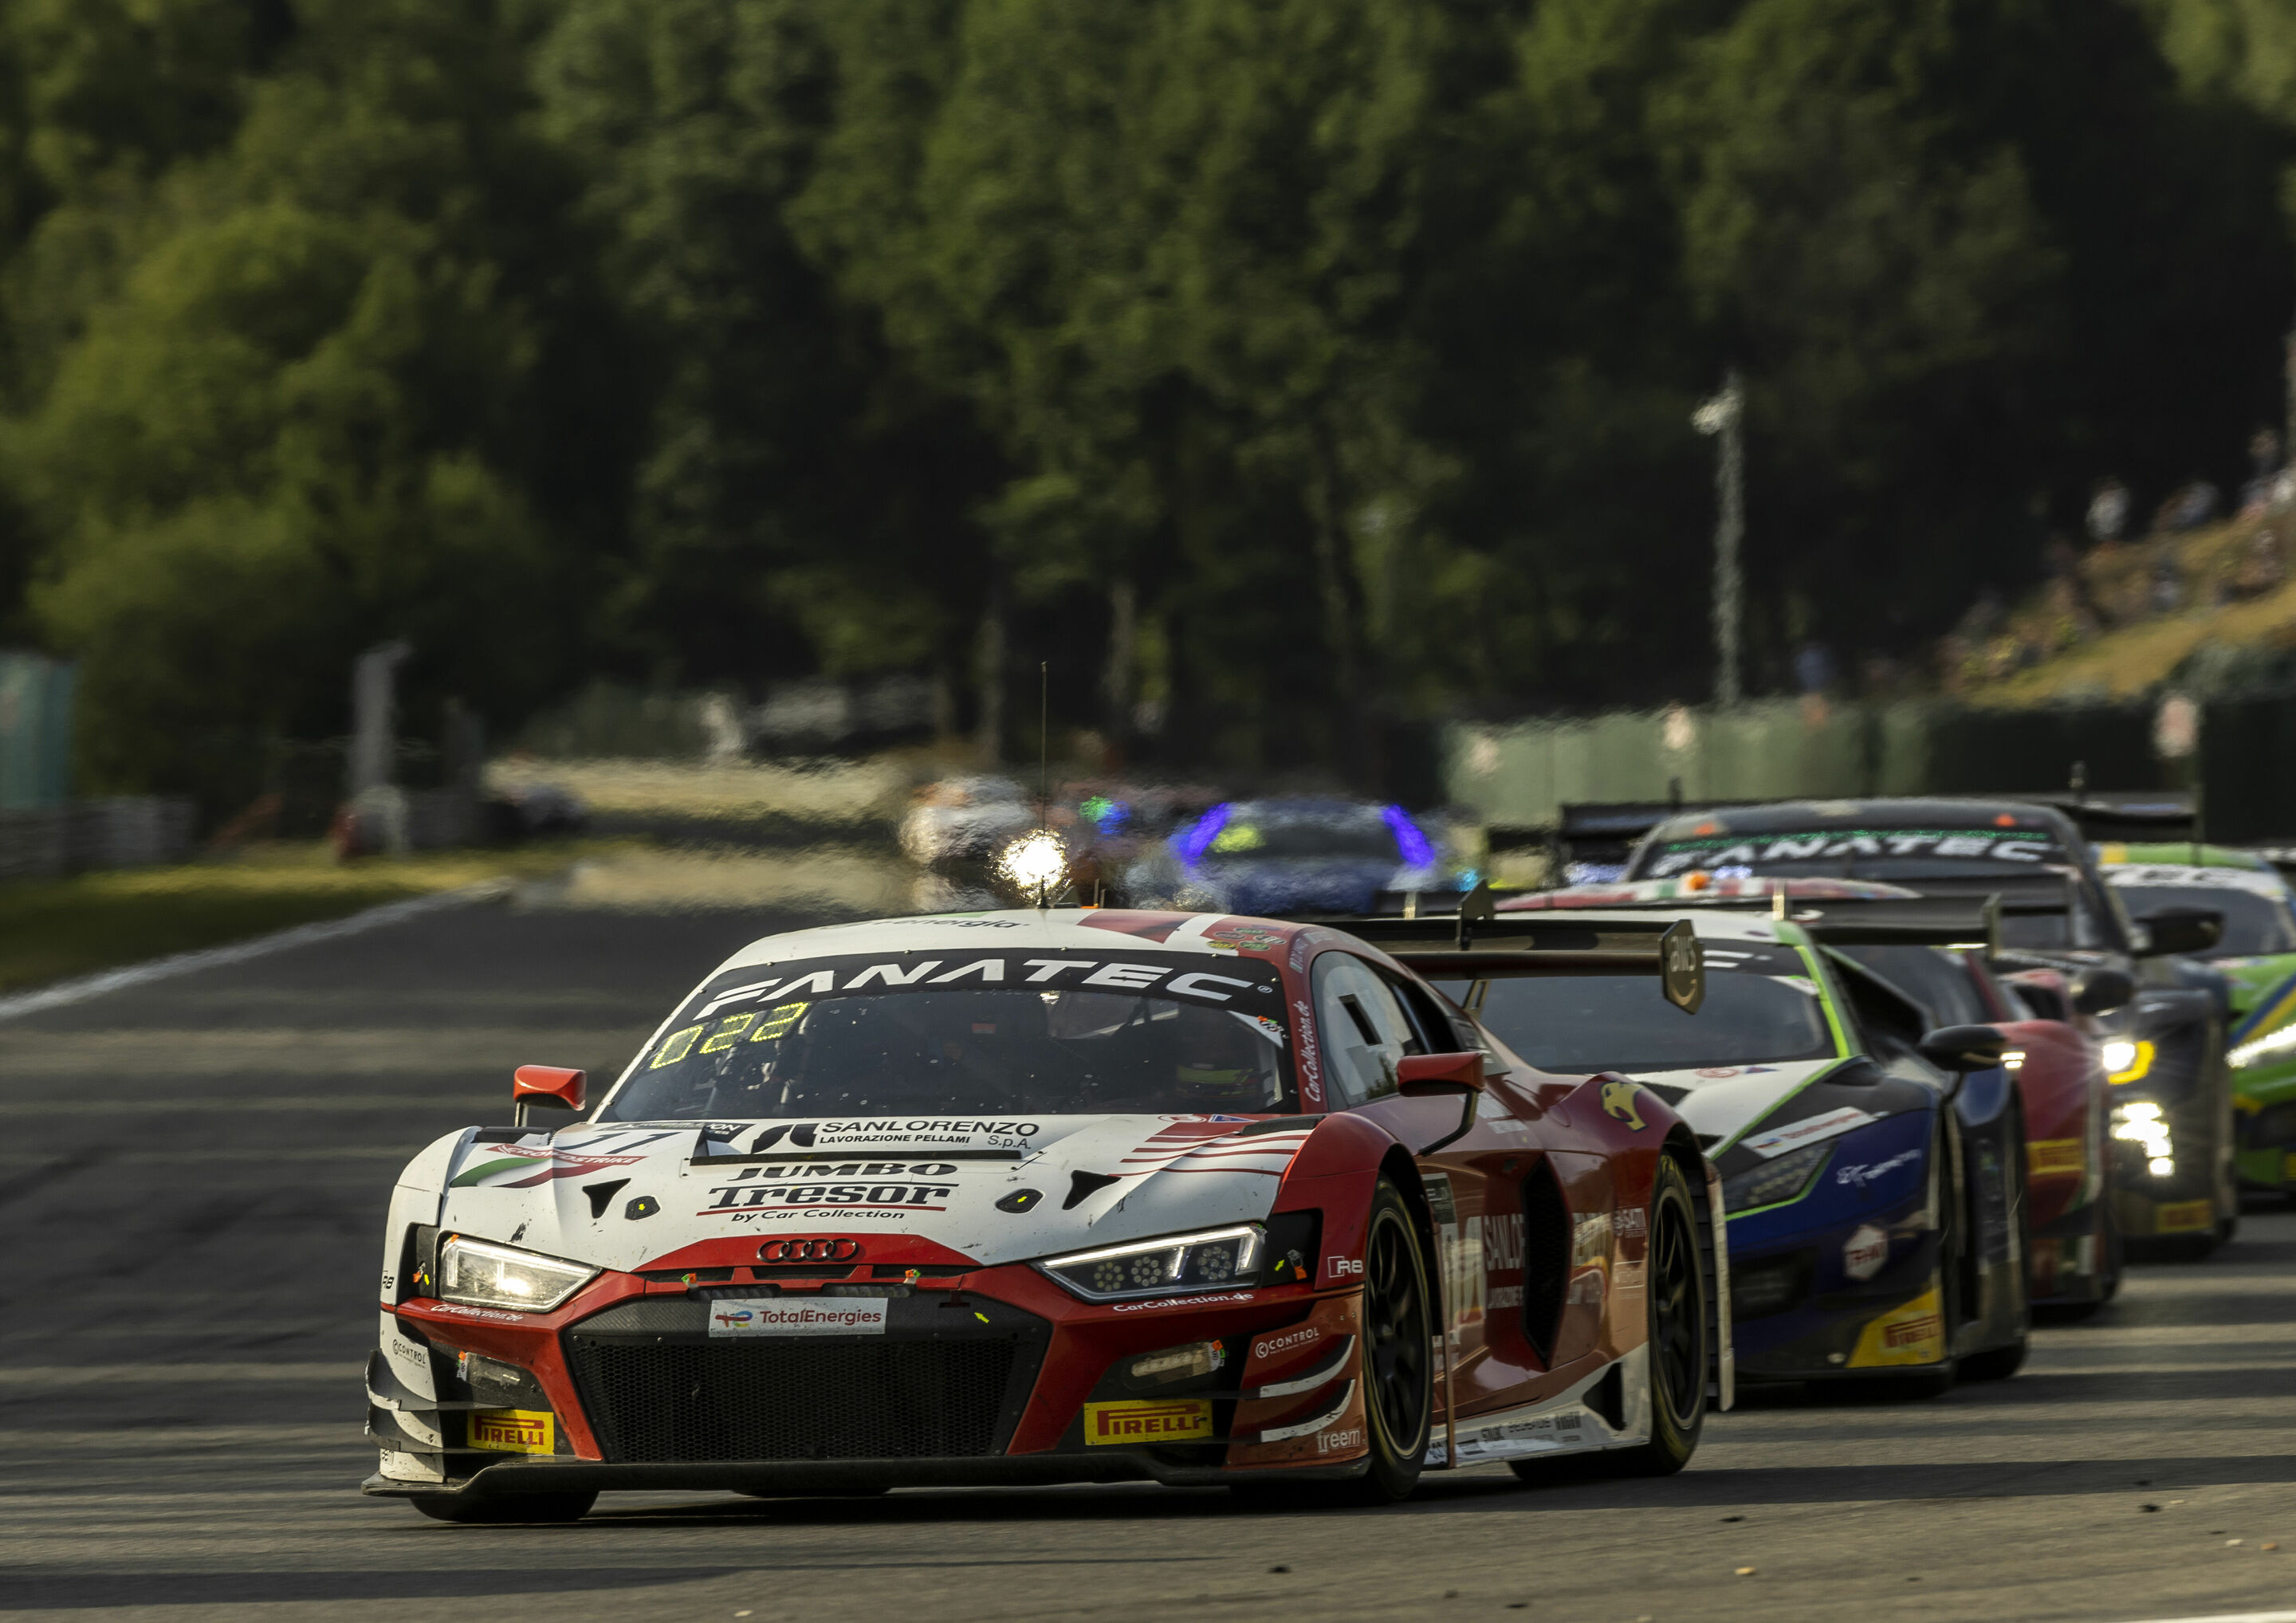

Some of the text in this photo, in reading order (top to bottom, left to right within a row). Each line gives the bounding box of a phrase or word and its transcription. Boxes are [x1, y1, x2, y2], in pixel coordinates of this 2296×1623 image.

[1648, 835, 2050, 877] FANATEC
[1669, 935, 1697, 973] aws
[693, 959, 1254, 1021] FANATEC
[649, 1001, 809, 1069] 022
[1292, 1000, 1321, 1102] CarCollection.de
[820, 1134, 970, 1144] LAVORAZIONE PELLAMI
[822, 1120, 1040, 1138] SANLORENZO
[987, 1134, 1032, 1149] S.p.A.
[507, 1146, 639, 1165] CROWDSTRIKE
[726, 1163, 958, 1181] JUMBO
[708, 1184, 952, 1209] Tresor
[731, 1208, 906, 1224] by Car Collection
[1337, 1259, 1363, 1274] R8
[430, 1303, 524, 1322] CarCollection.de
[1112, 1292, 1255, 1312] CarCollection.de
[760, 1308, 882, 1326] TotalEnergies
[1268, 1326, 1320, 1350] CONTROL
[399, 1342, 427, 1365] CONTROL
[474, 1415, 545, 1445] PIRELLI
[1097, 1403, 1201, 1436] PIRELLI
